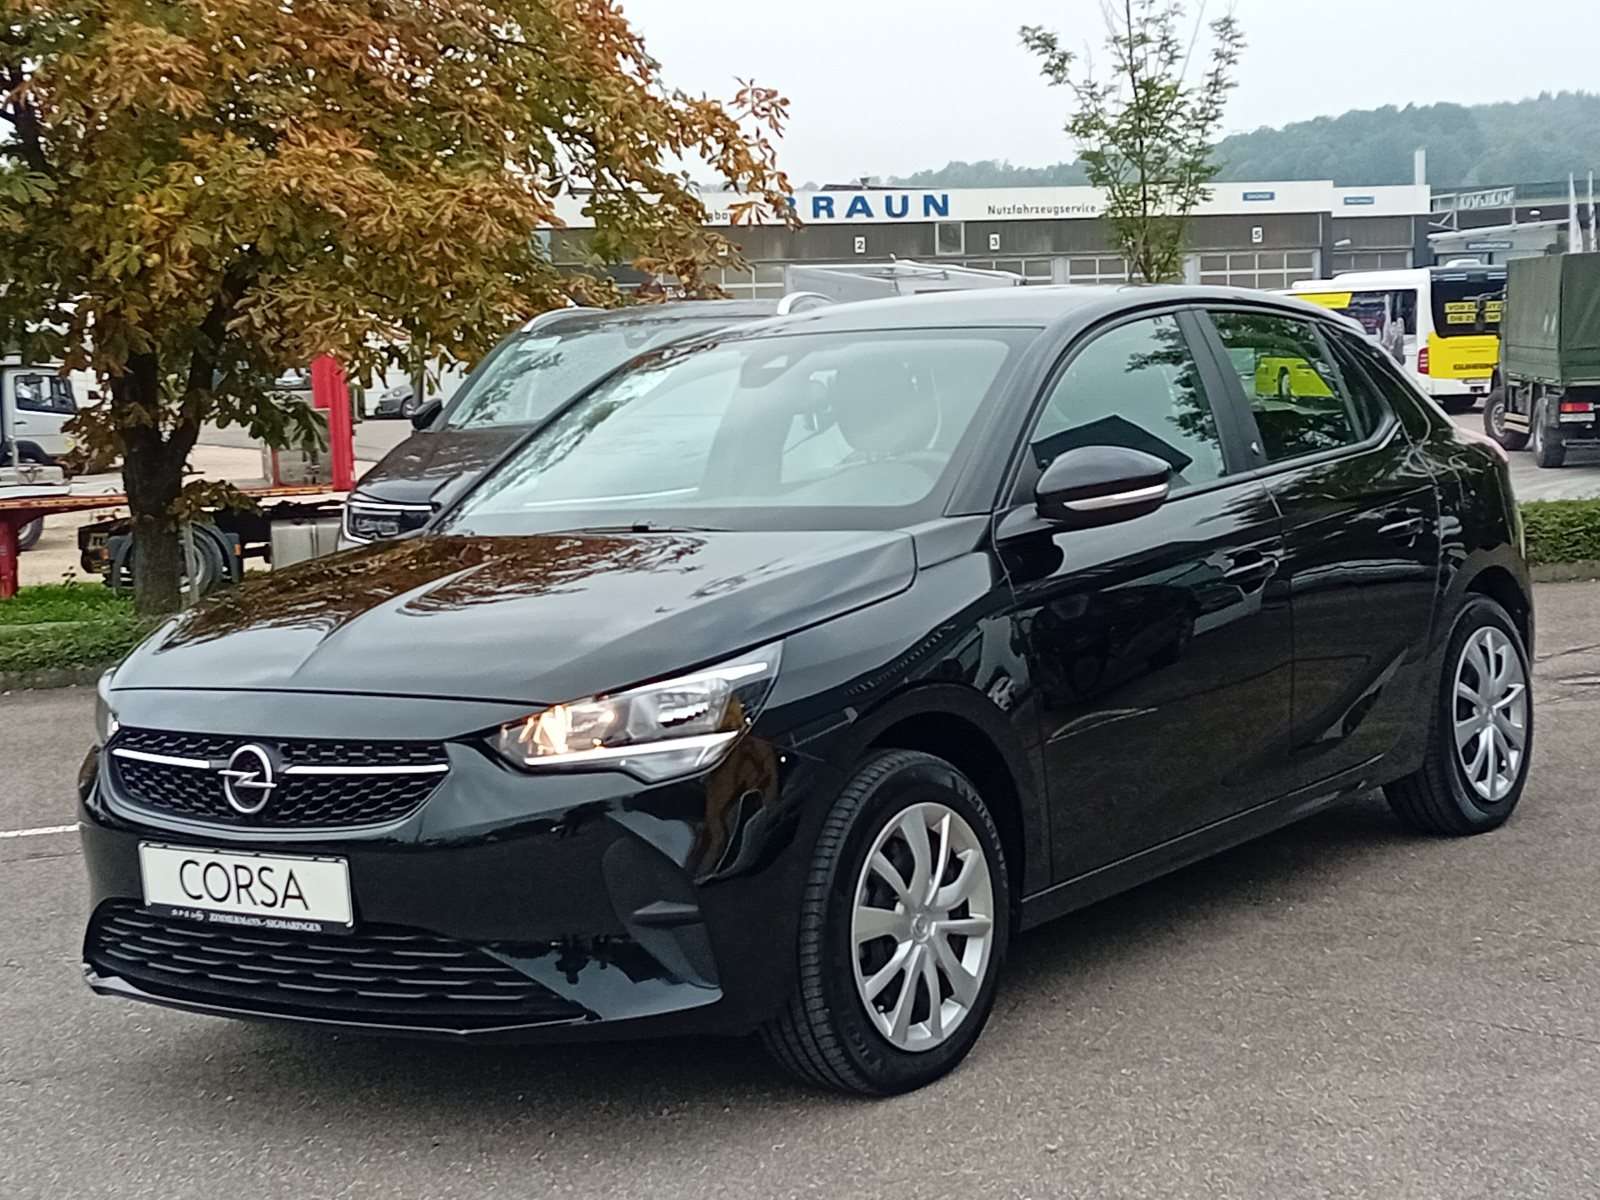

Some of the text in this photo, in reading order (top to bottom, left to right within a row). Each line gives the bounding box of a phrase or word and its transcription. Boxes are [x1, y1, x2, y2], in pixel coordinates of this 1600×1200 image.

[987, 203, 1097, 216] Nutzfahrzeugservice
[1253, 229, 1263, 240] 5
[856, 239, 865, 249] 2
[990, 236, 999, 247] 3
[179, 859, 310, 911] CORSA
